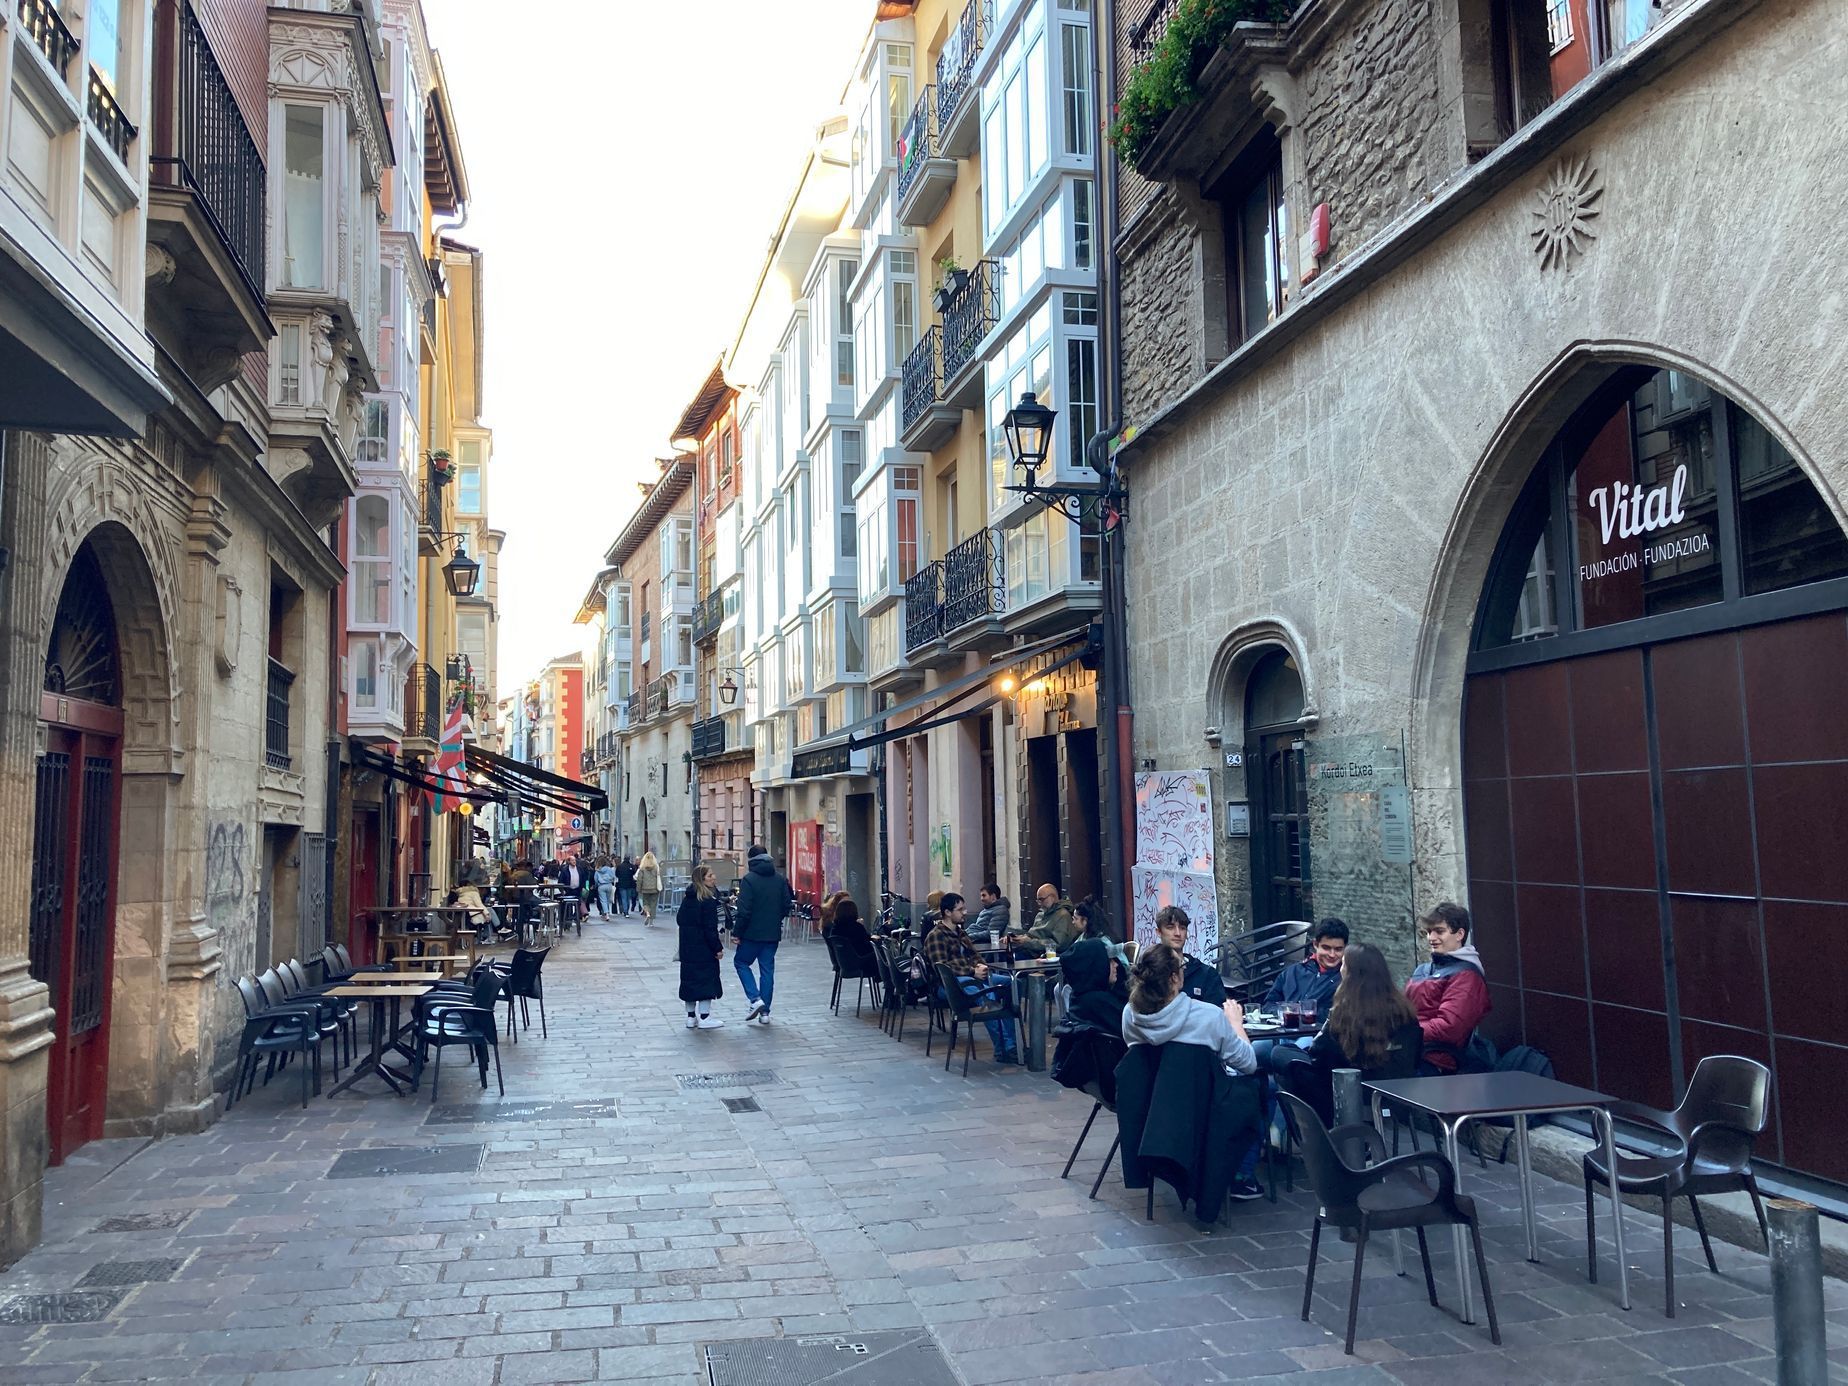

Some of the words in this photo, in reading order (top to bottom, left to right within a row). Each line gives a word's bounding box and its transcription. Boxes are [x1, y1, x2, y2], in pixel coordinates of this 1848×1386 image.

[1588, 464, 1687, 544] Vital
[1580, 552, 1638, 581] FUNDACIÓN
[1644, 533, 1709, 565] FUNDAZIOA
[1228, 755, 1240, 763] 24
[1321, 763, 1347, 779] Kordoi
[1349, 761, 1373, 777] Etxea
